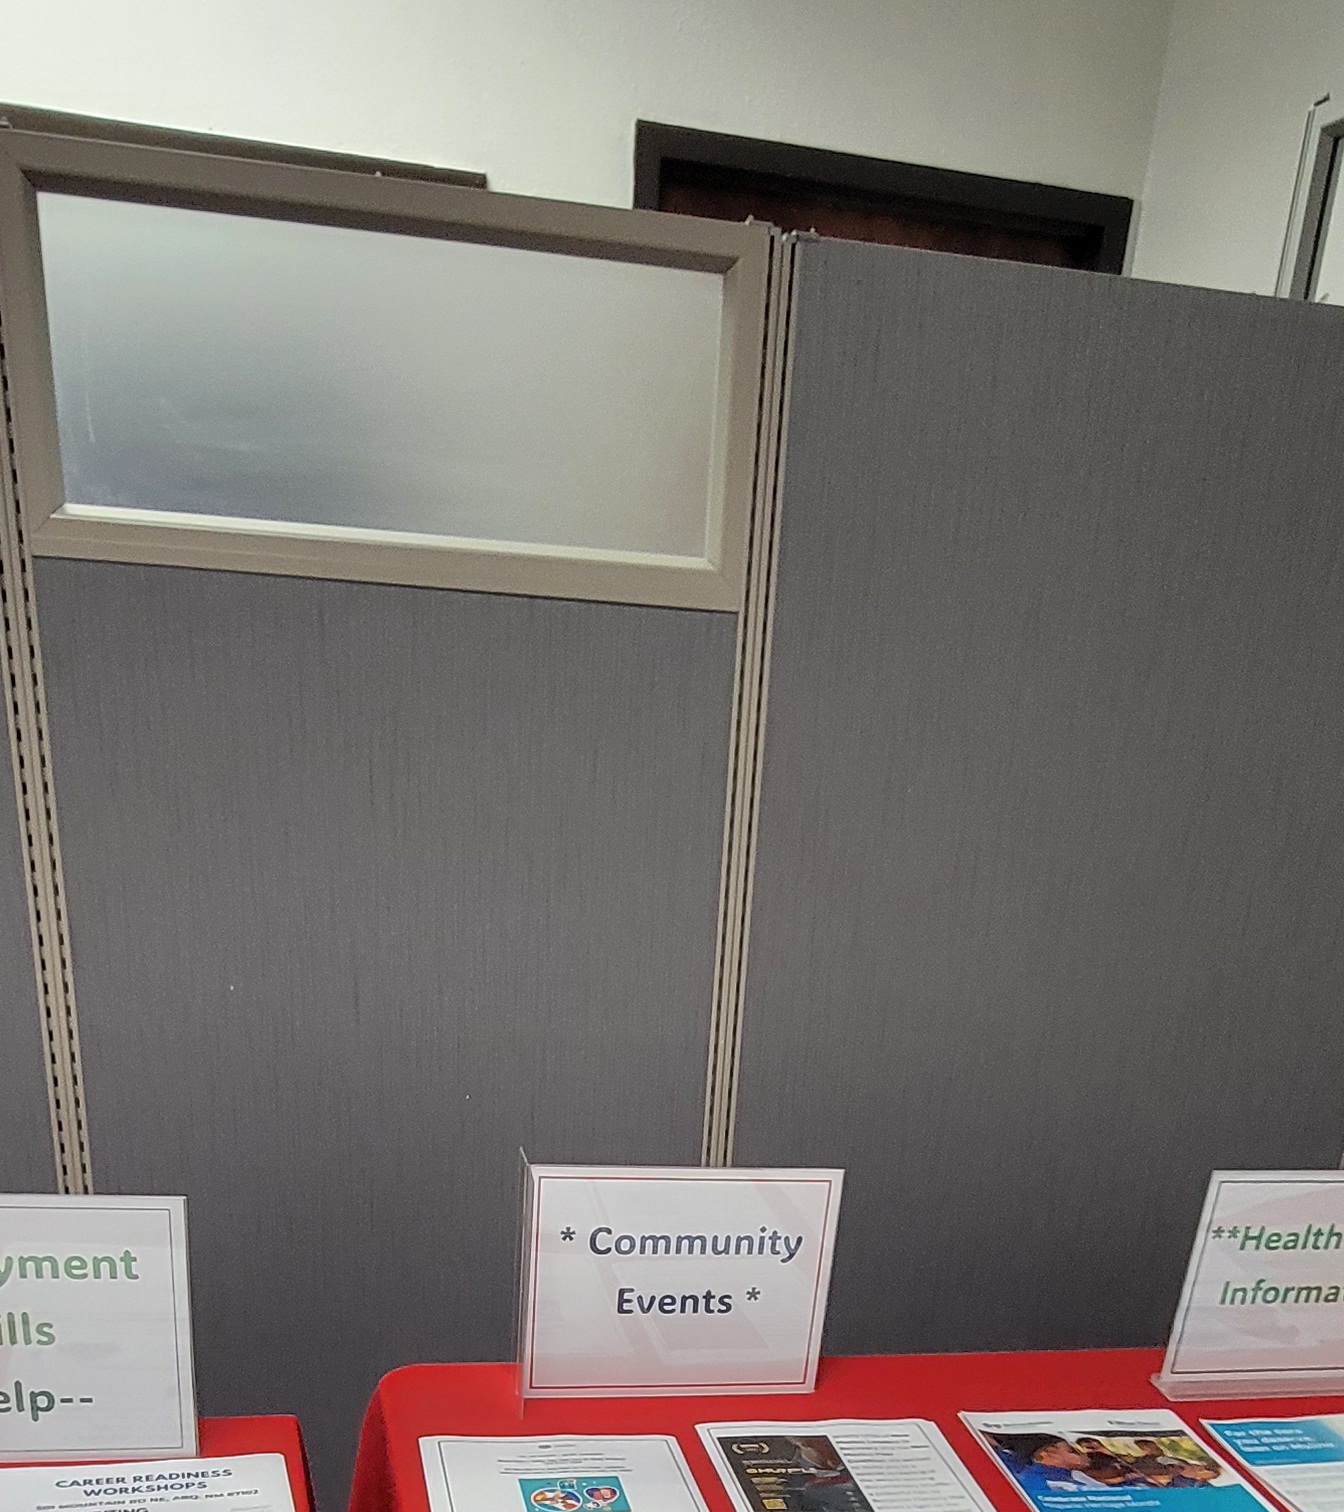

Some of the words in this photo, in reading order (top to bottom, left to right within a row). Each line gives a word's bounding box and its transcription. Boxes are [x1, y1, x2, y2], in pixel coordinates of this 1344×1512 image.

[588, 1226, 804, 1263] Community
[617, 1287, 733, 1315] Events
[55, 1475, 127, 1488] CAREER
[133, 1469, 233, 1483] READINESS
[83, 1481, 207, 1497] WORKSHOPS
